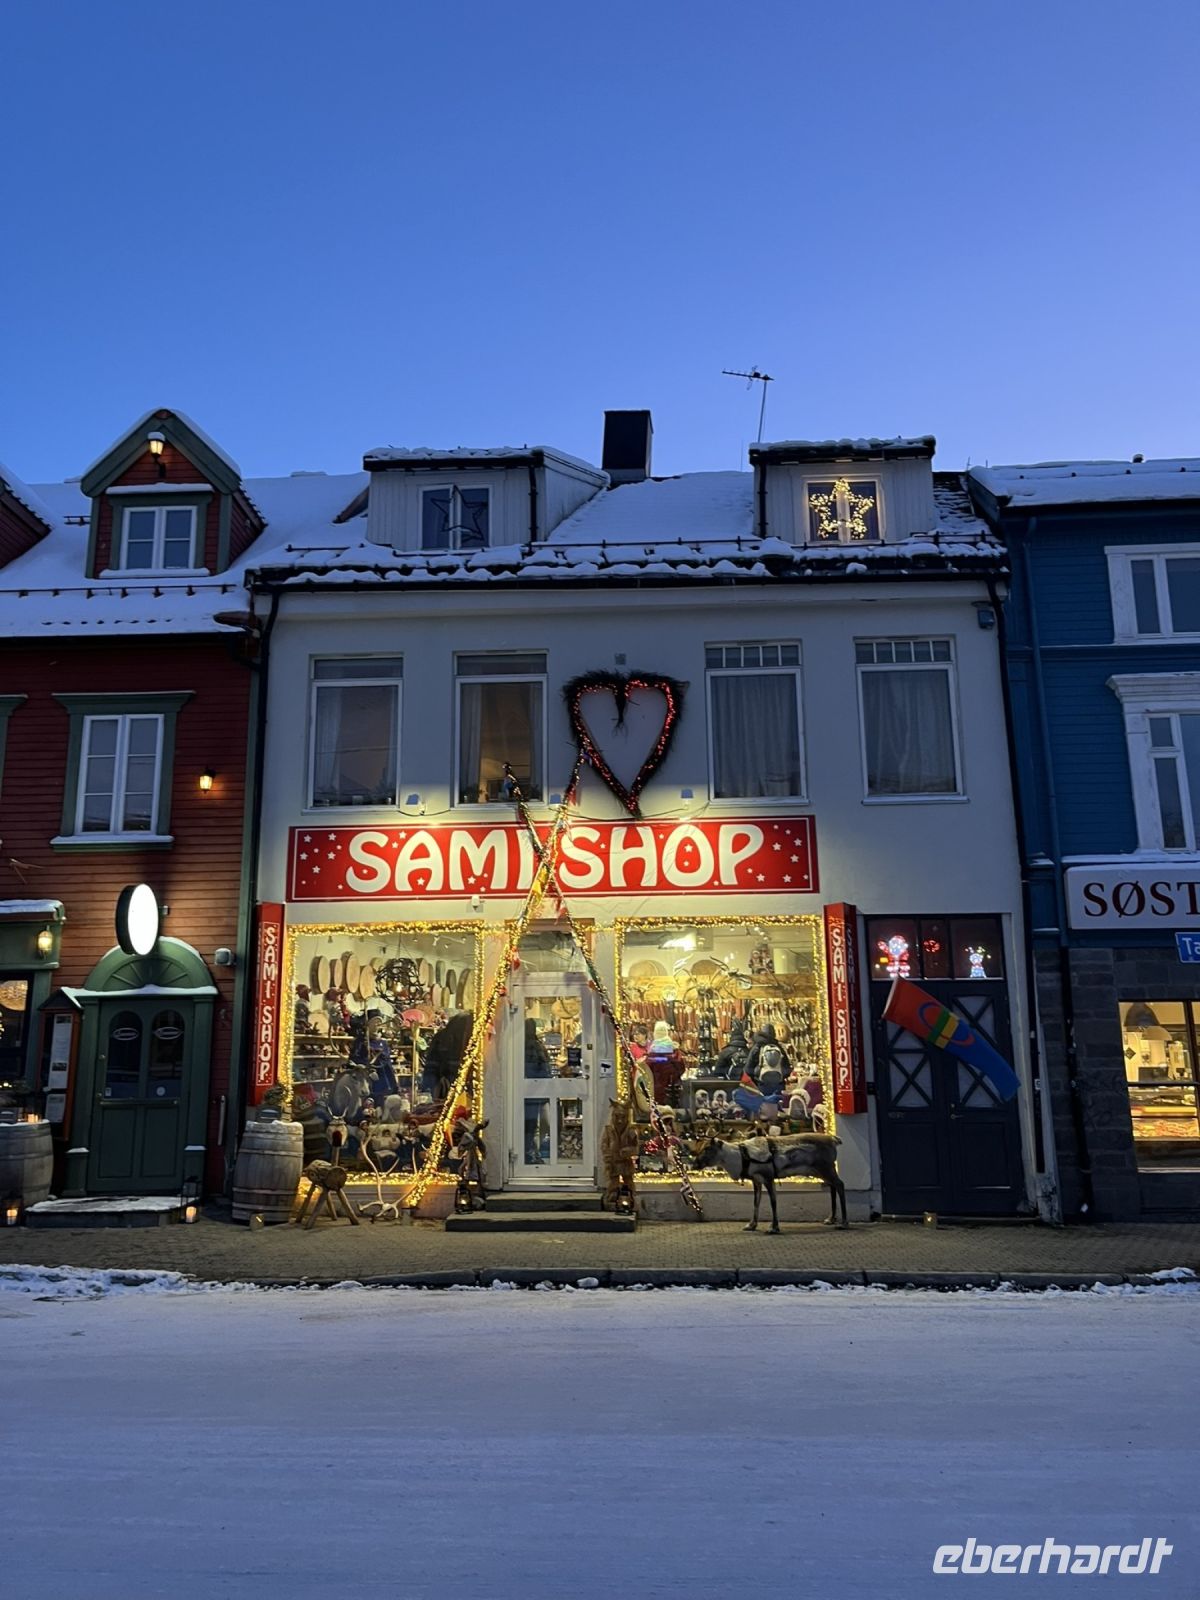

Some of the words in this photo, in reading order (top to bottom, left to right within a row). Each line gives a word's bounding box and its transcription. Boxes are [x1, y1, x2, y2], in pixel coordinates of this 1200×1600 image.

[345, 829, 534, 893] SAMI
[558, 824, 764, 889] SHOP
[1083, 880, 1200, 918] SØST
[263, 926, 277, 999] SAMI
[832, 928, 845, 1003] SAMI
[259, 1005, 273, 1081] SHOP
[836, 1009, 849, 1087] SHOP
